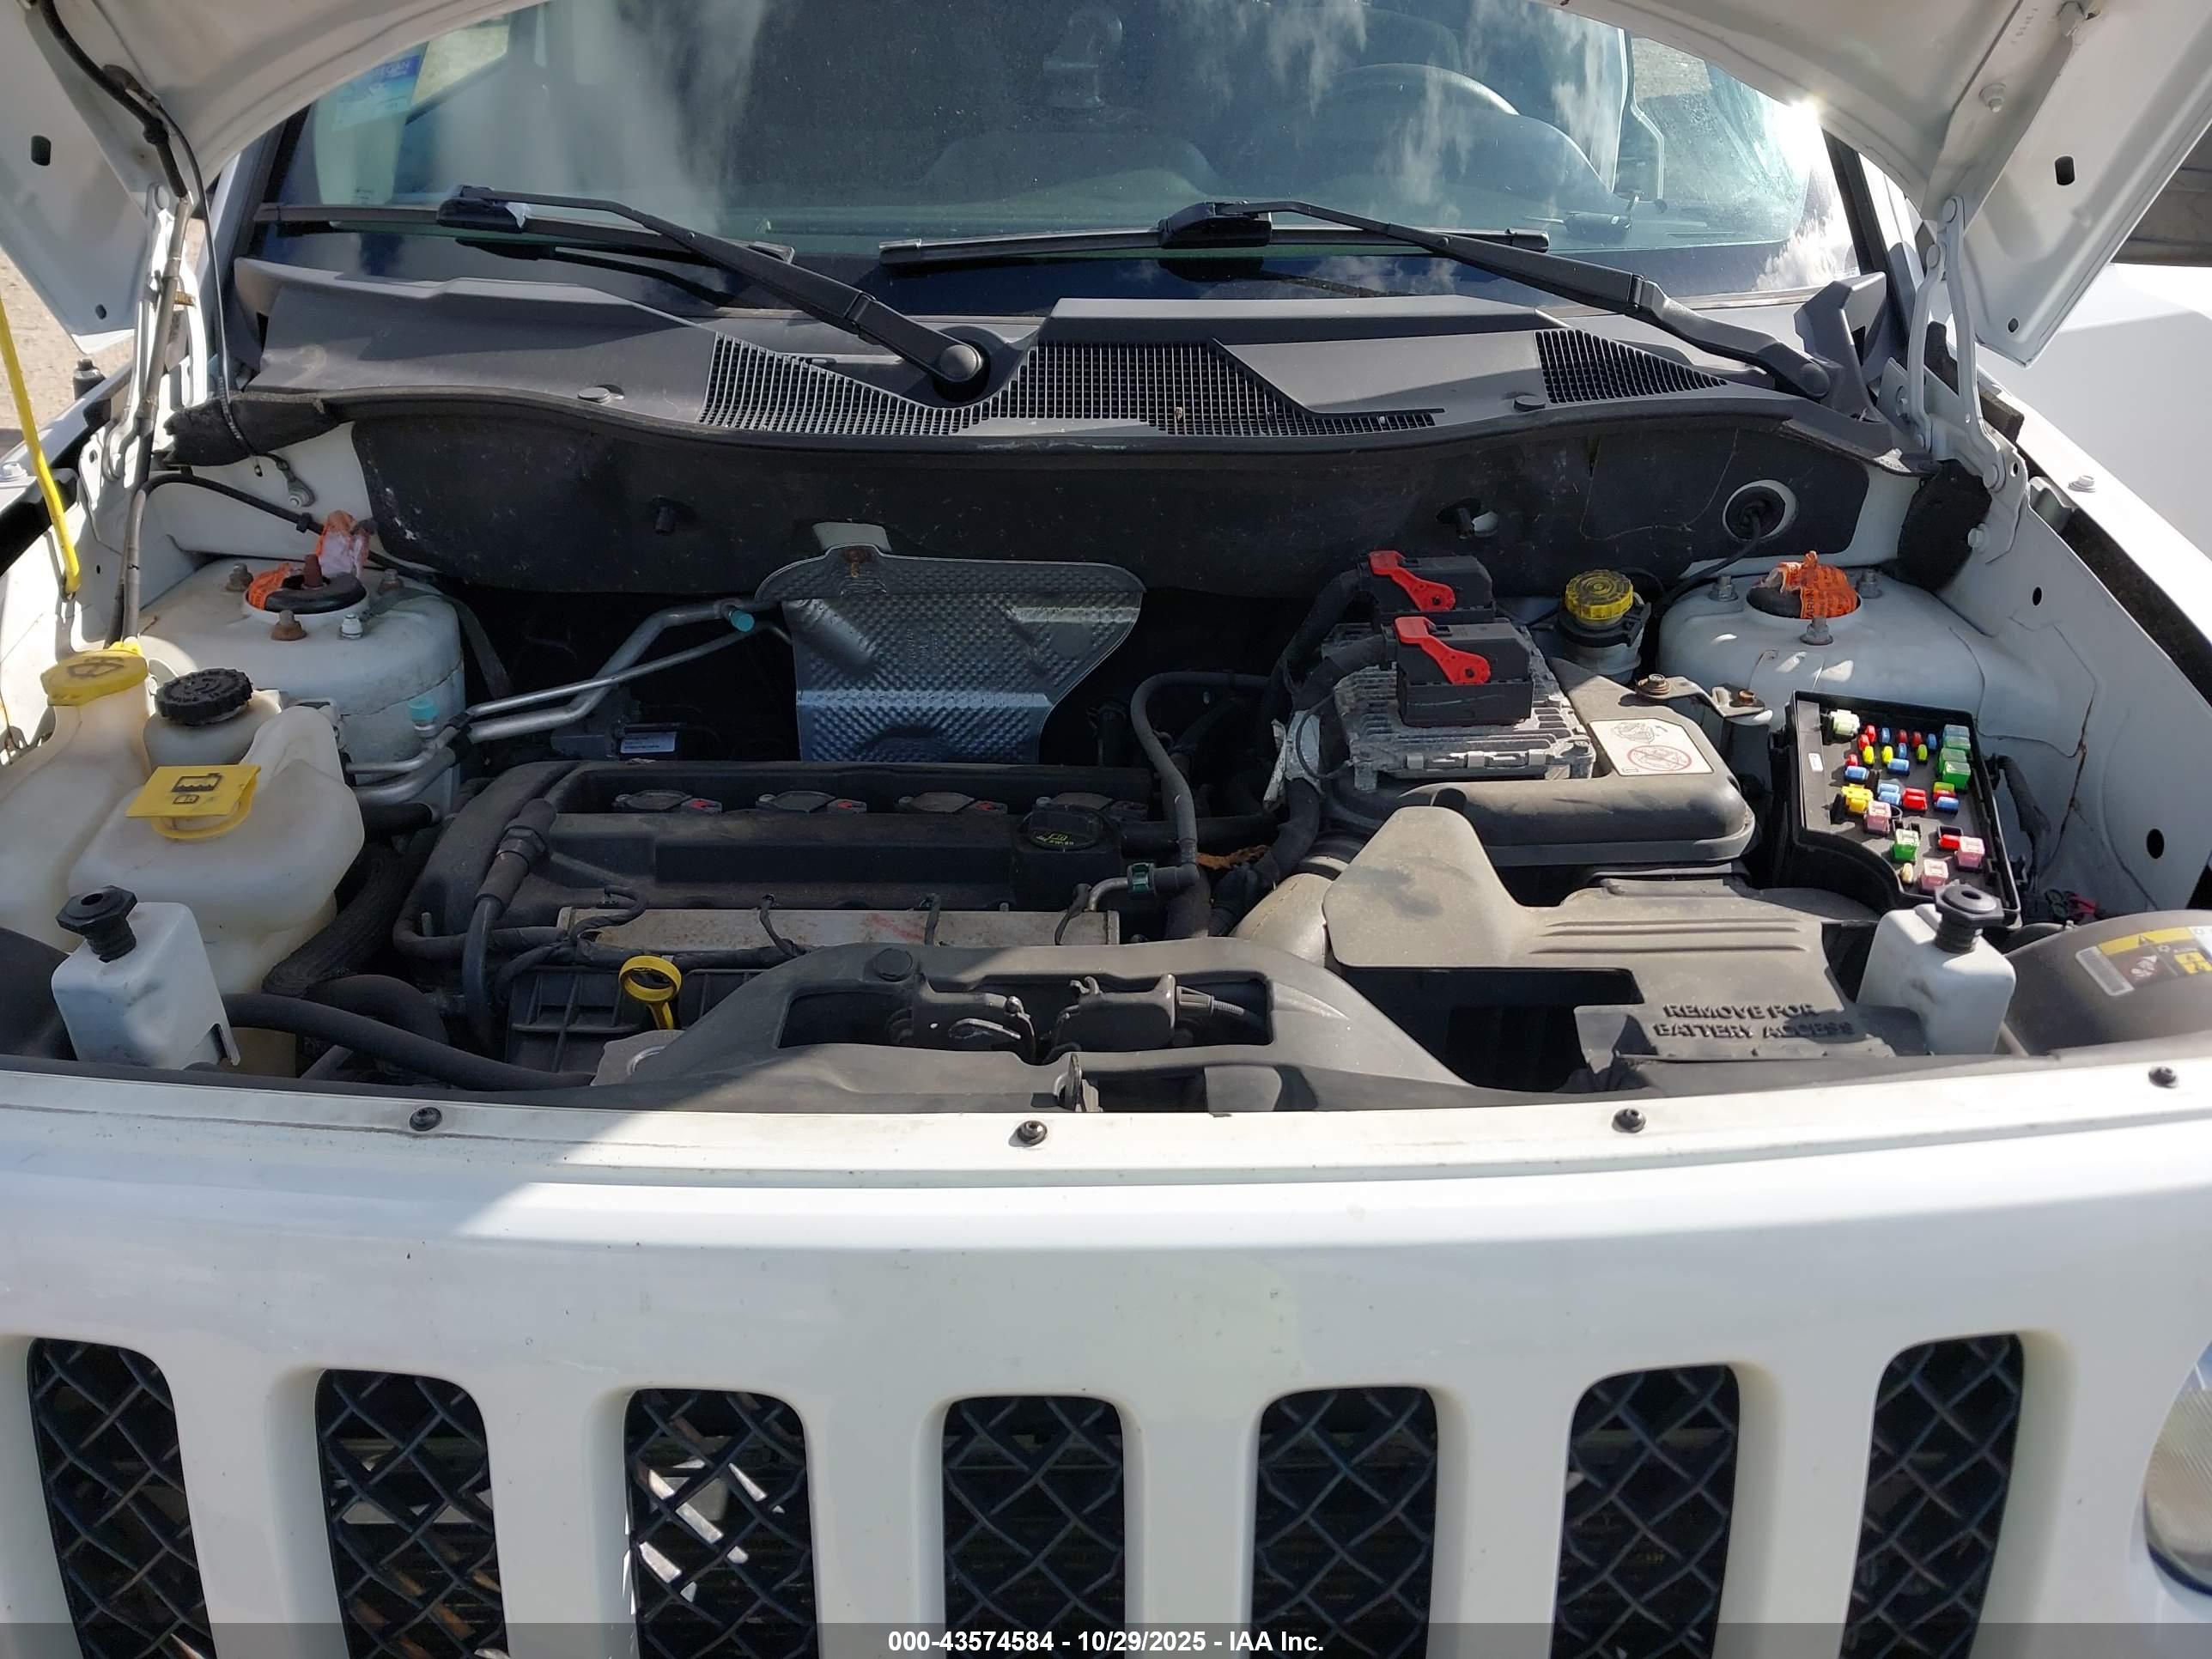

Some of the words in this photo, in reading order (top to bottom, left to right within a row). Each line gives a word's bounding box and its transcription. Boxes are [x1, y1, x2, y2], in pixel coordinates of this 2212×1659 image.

[1662, 1003, 1765, 1019] REMOVE
[1766, 1003, 1820, 1019] FOR
[1652, 1023, 1754, 1038] BATTERY
[1763, 1021, 1855, 1038] ACCESS
